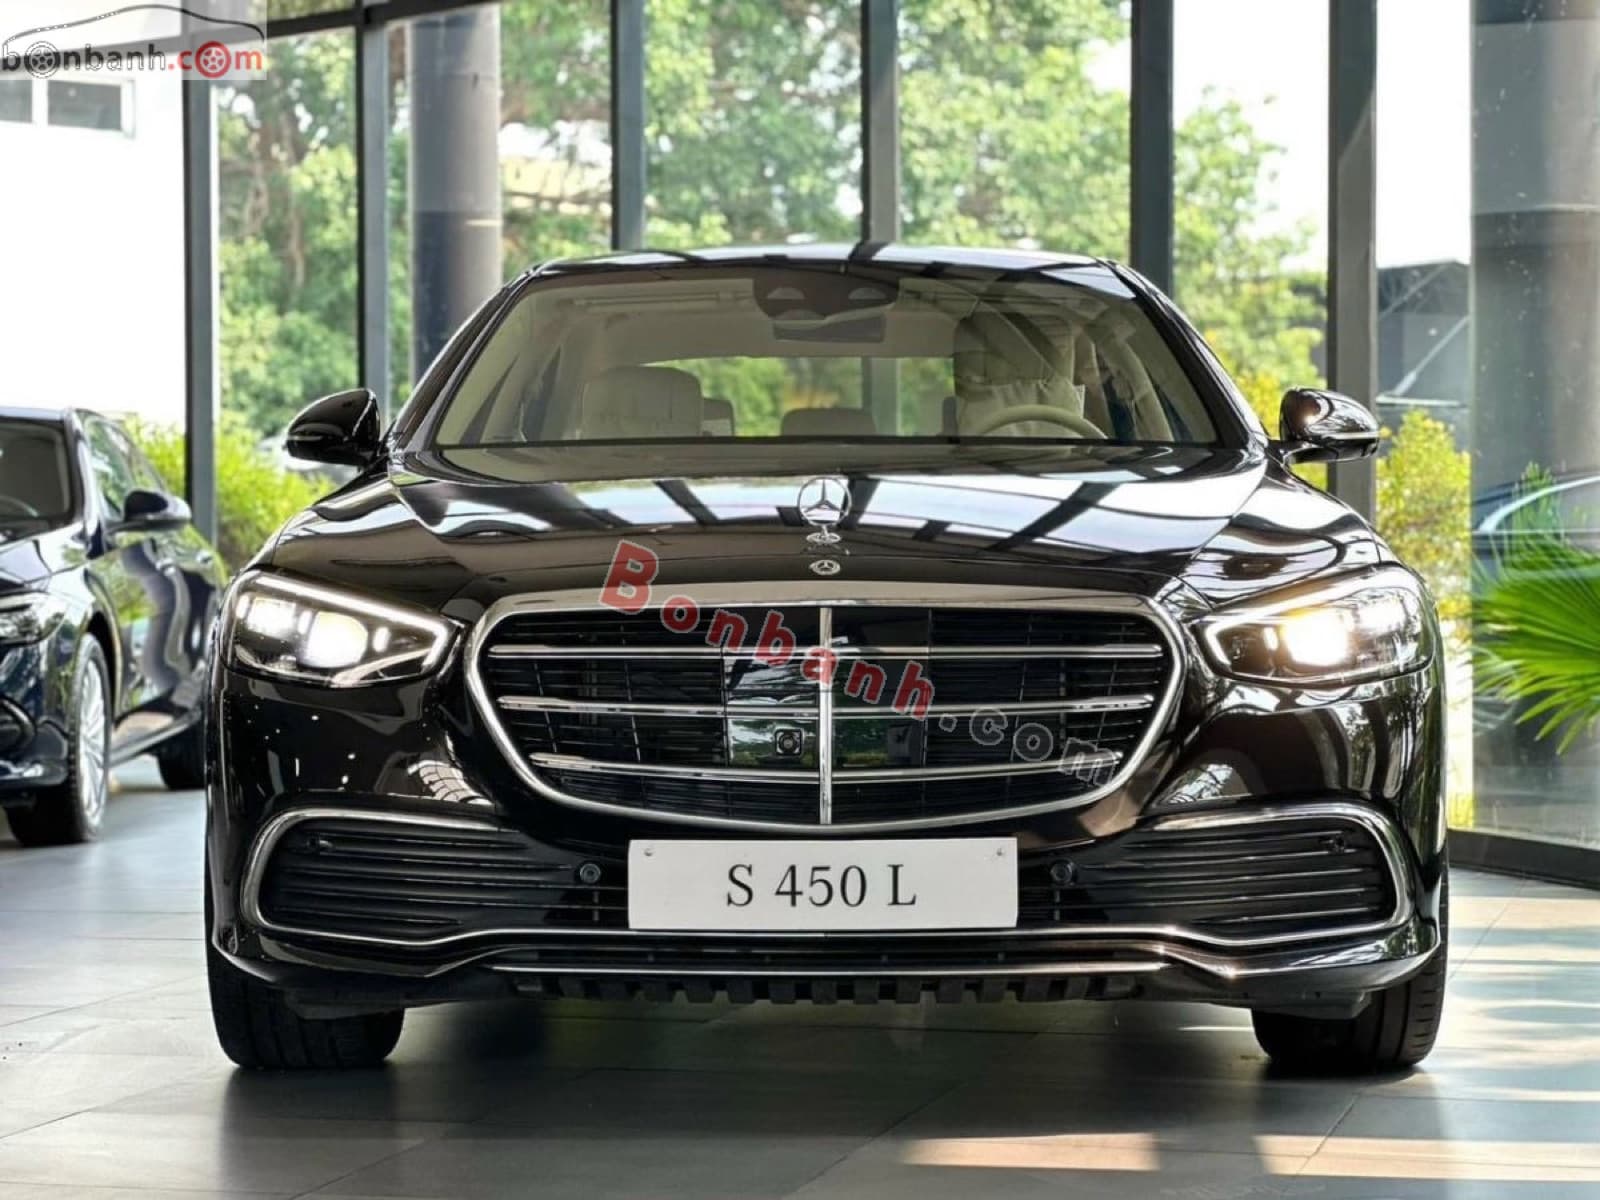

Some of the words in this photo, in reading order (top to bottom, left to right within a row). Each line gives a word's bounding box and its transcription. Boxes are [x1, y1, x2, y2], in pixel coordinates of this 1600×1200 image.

[727, 864, 753, 907] S
[775, 864, 867, 907] 450
[887, 864, 917, 906] L
